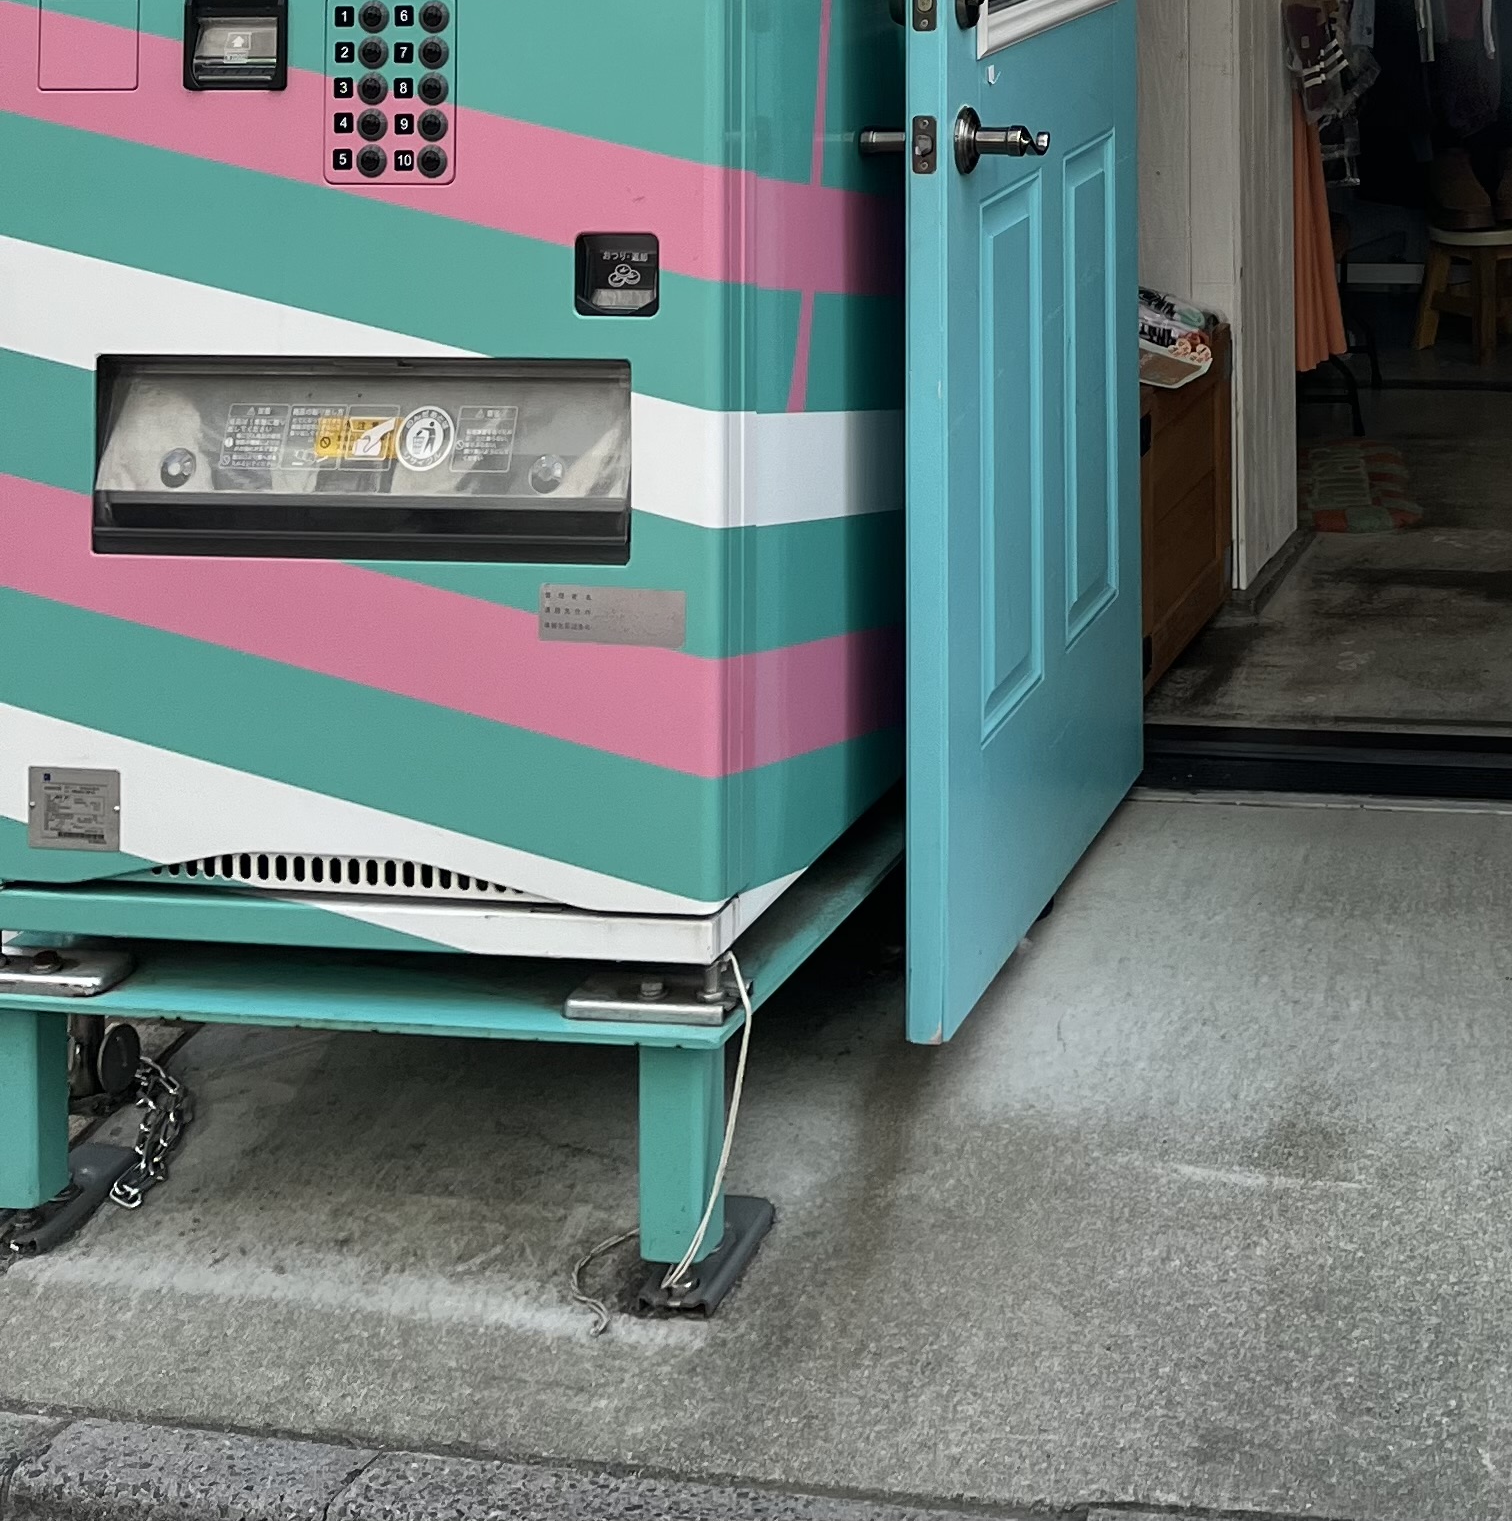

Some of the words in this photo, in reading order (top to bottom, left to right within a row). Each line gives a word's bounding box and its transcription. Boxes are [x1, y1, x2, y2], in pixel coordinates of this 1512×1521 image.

[340, 11, 349, 22] 1
[399, 10, 409, 21] 6
[340, 47, 349, 58] 2
[399, 47, 408, 58] 7
[339, 82, 348, 93] 3
[399, 82, 408, 94] 8
[339, 118, 348, 129] 4
[399, 118, 409, 129] 9
[338, 154, 347, 165] 5
[397, 155, 412, 166] 10
